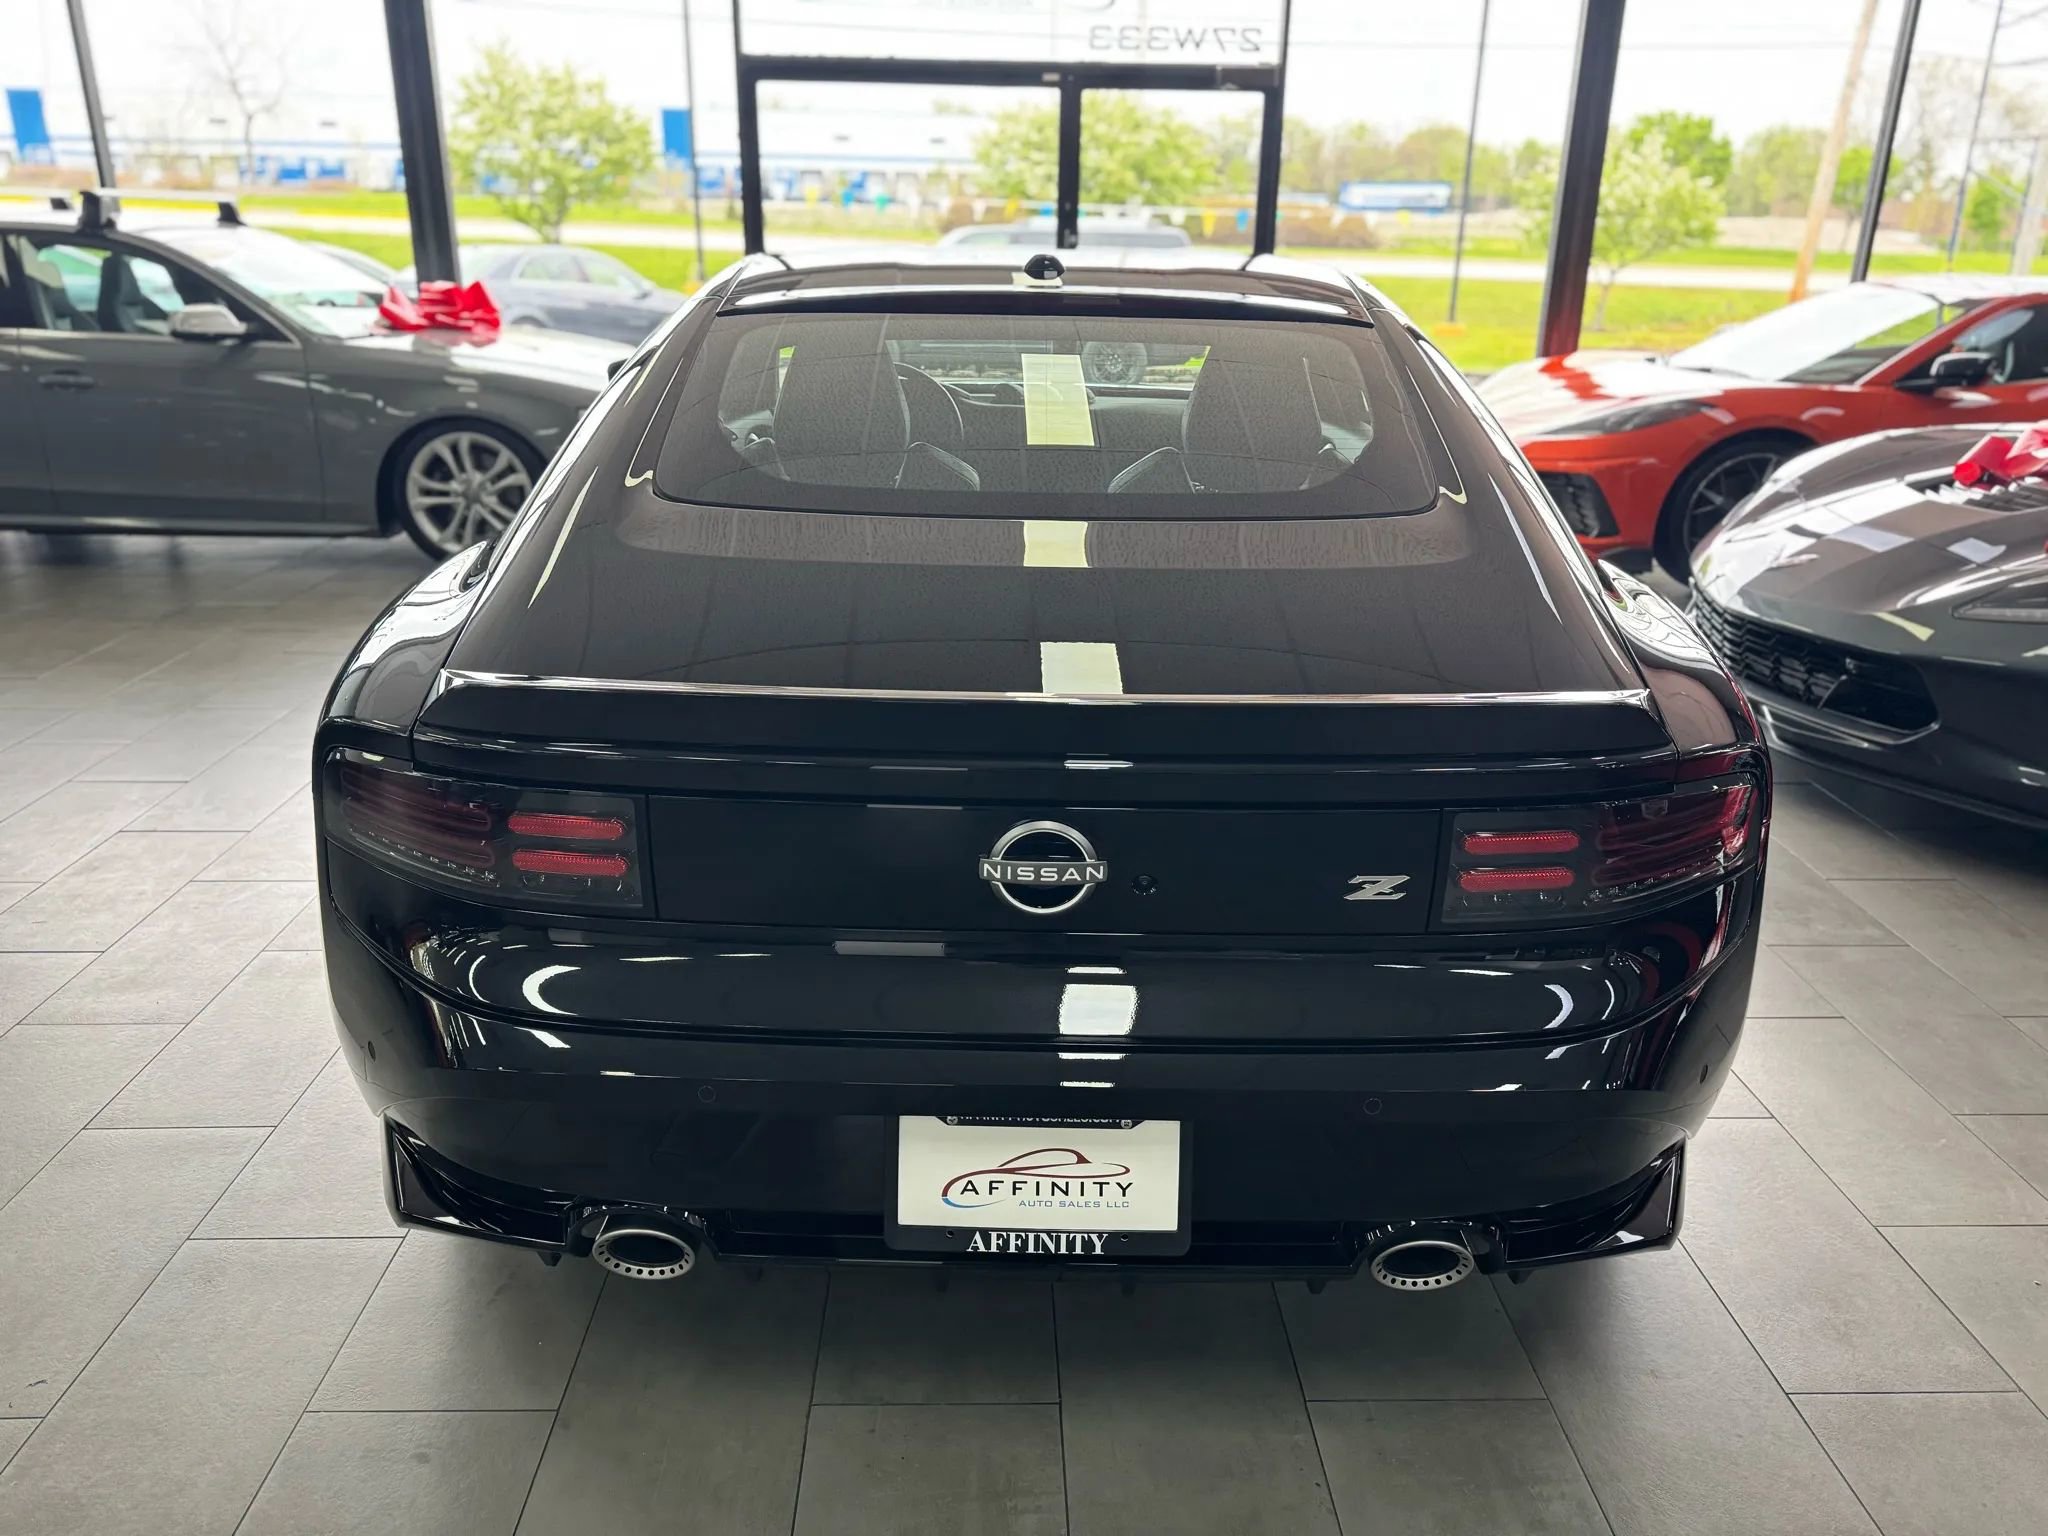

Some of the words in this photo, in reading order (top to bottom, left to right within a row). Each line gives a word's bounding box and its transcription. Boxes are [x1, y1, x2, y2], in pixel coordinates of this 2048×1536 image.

[982, 863, 1105, 882] NISSAN
[1343, 875, 1411, 901] Z
[960, 1180, 1134, 1197] AFFINITY
[1018, 1199, 1053, 1208] AUTO
[1058, 1200, 1101, 1209] SALES
[1106, 1201, 1130, 1209] LLC
[967, 1231, 1109, 1255] AFFINITY
